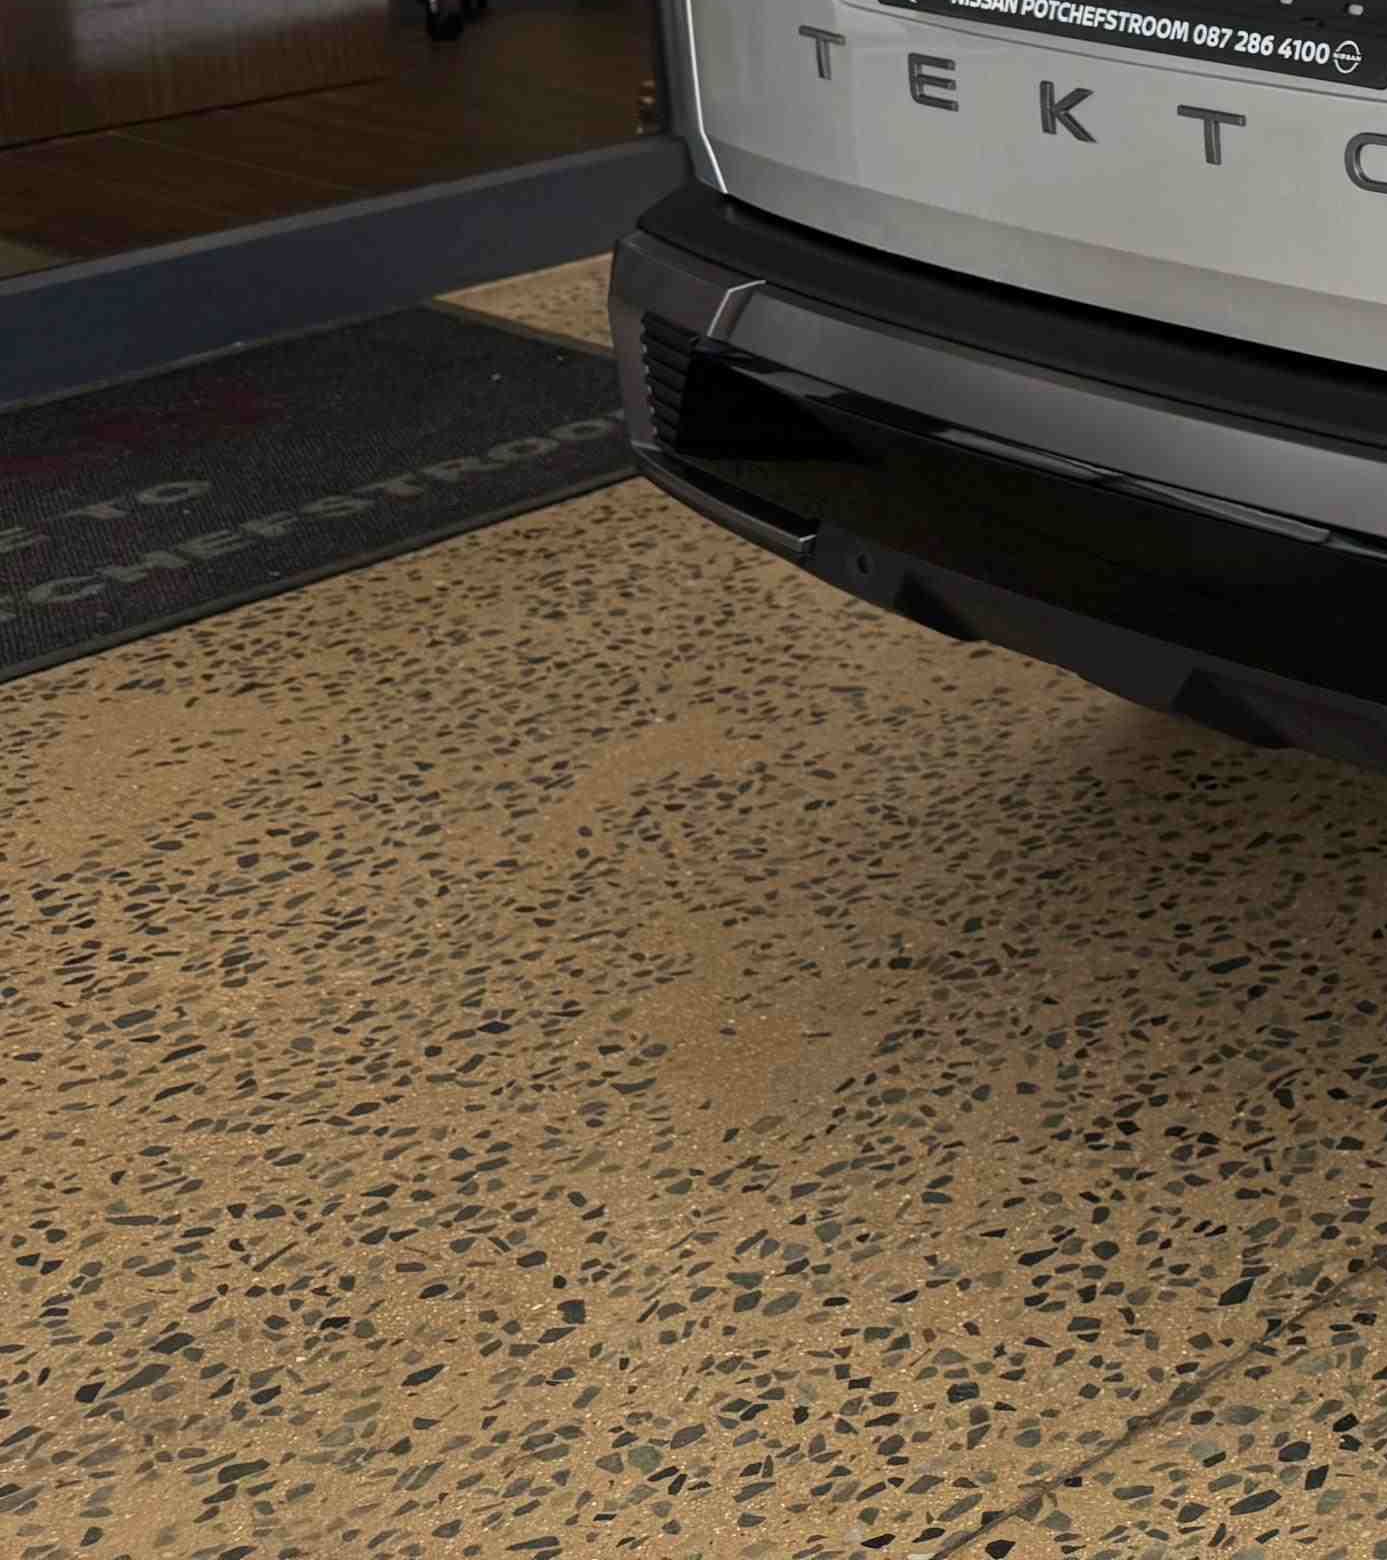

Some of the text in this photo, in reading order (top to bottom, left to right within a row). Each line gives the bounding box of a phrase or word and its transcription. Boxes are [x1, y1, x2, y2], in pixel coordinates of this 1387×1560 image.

[1192, 23, 1233, 49] 087
[1234, 30, 1275, 56] 286
[1277, 37, 1330, 64] 4100
